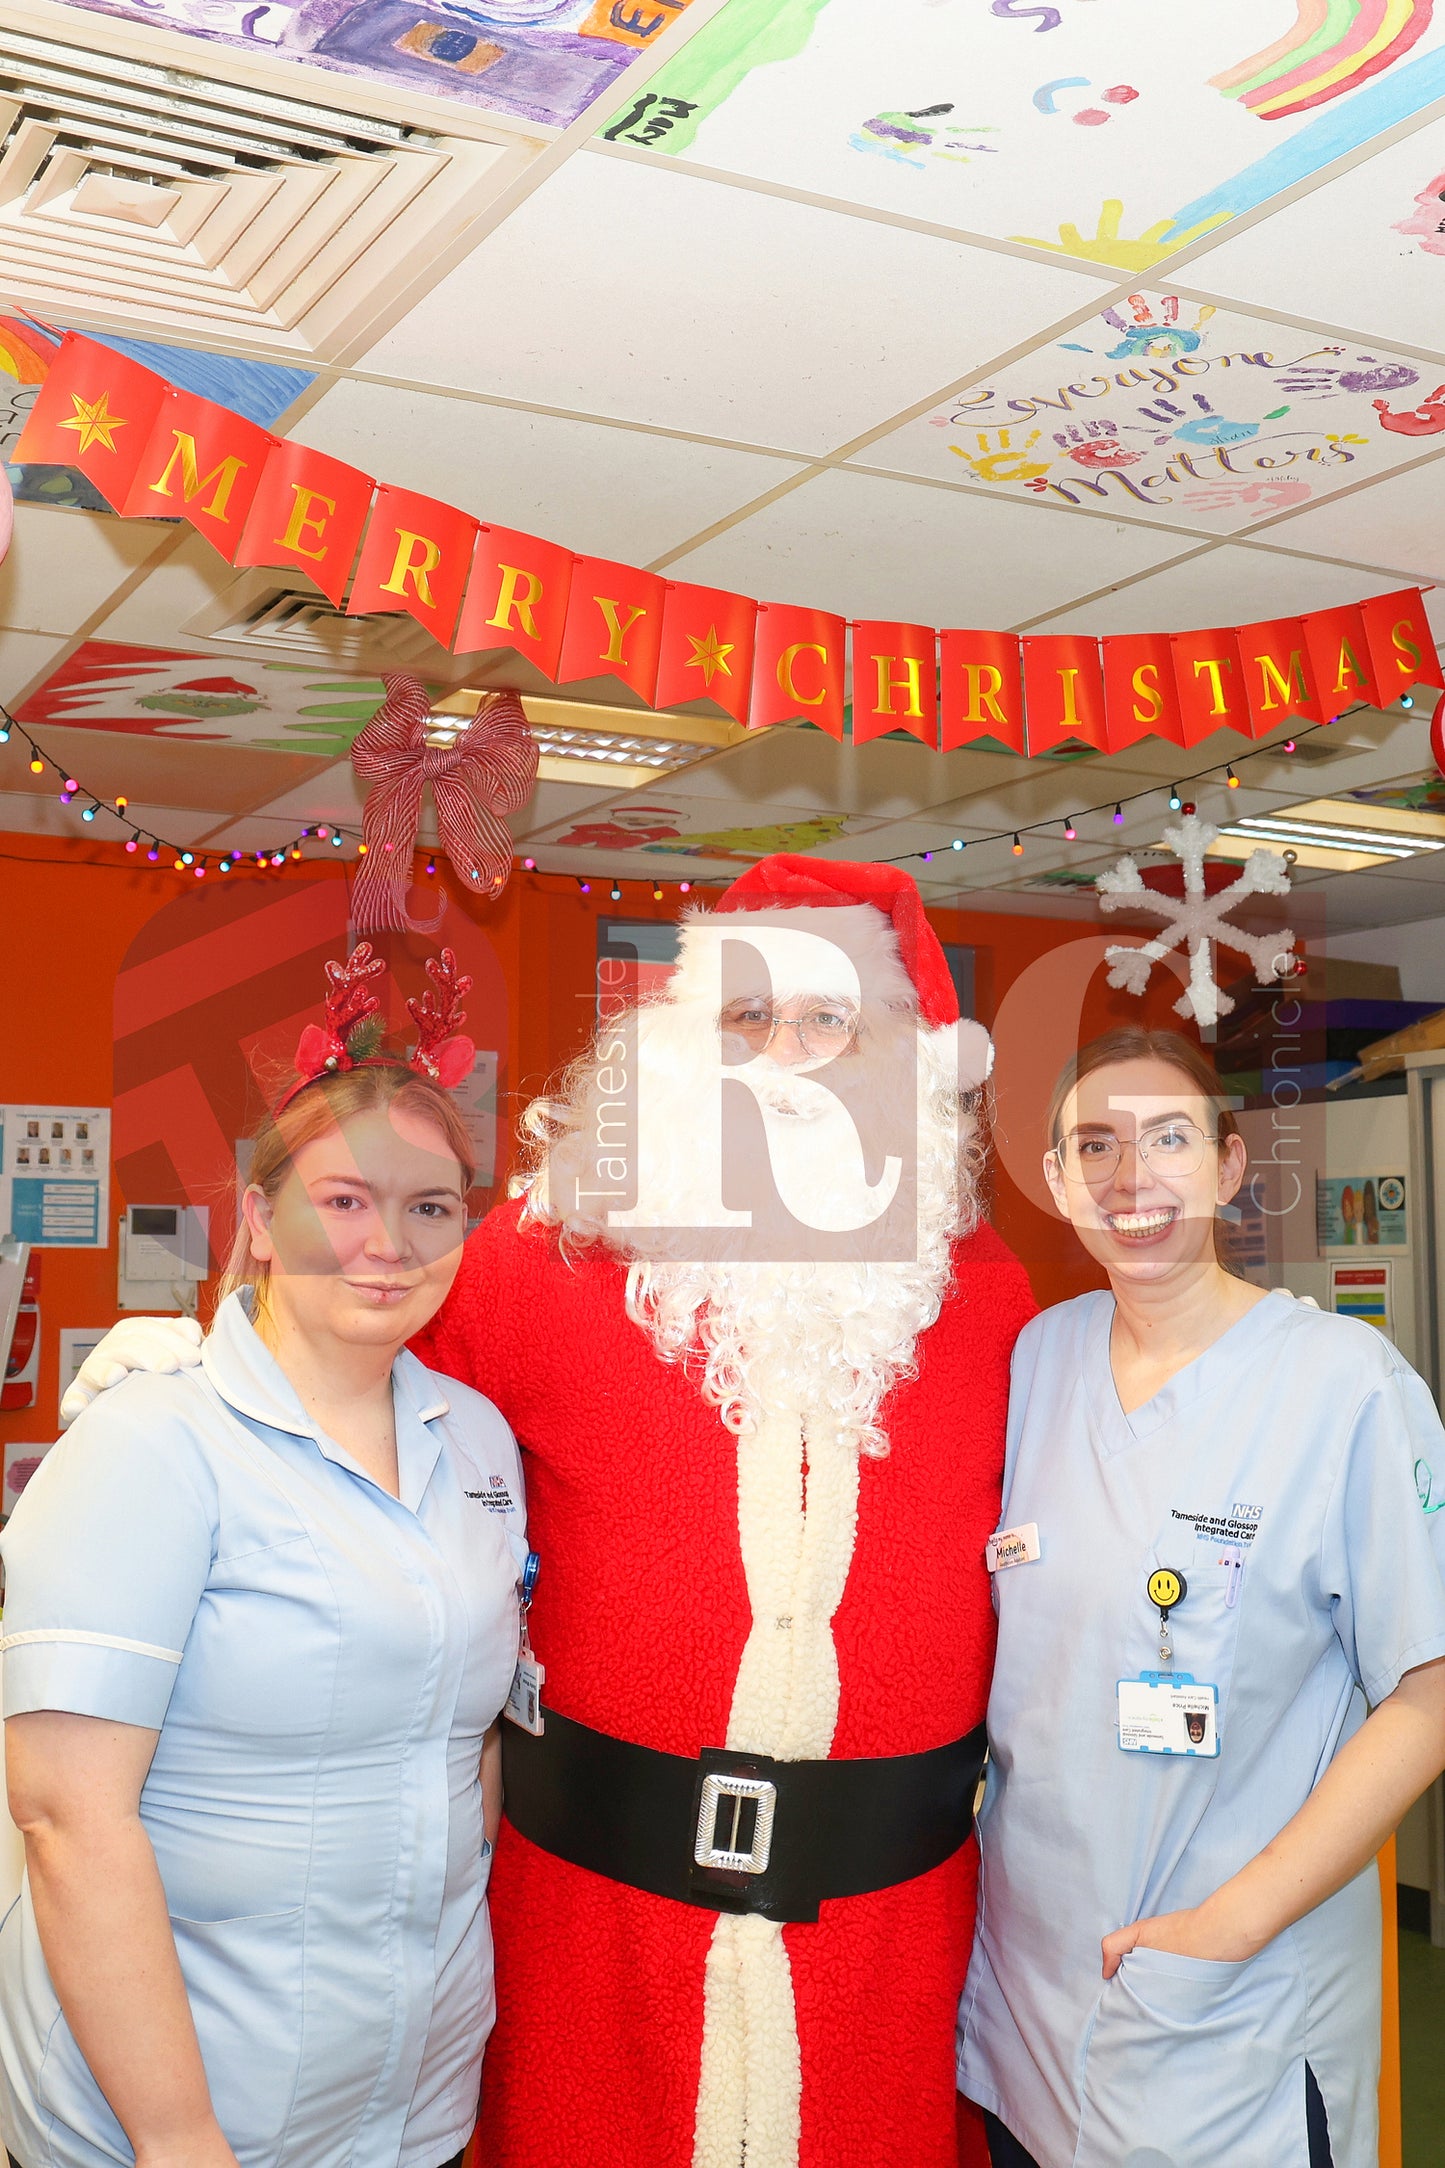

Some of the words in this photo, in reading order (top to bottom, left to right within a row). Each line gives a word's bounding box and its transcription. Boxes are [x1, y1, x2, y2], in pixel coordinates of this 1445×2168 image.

[951, 350, 1341, 427] Everyone
[1048, 432, 1355, 505] Matters
[149, 430, 647, 667] MERRY
[777, 619, 1422, 727] CHRISTMAS
[1232, 1503, 1262, 1519] NHS
[1171, 1509, 1208, 1523] Tameside
[1209, 1517, 1226, 1526] and
[1228, 1520, 1258, 1532] Glossop
[1194, 1523, 1239, 1538] Integrated
[997, 1541, 1026, 1559] Michelle
[1172, 1702, 1187, 1710] Price
[1187, 1703, 1210, 1711] Michelle
